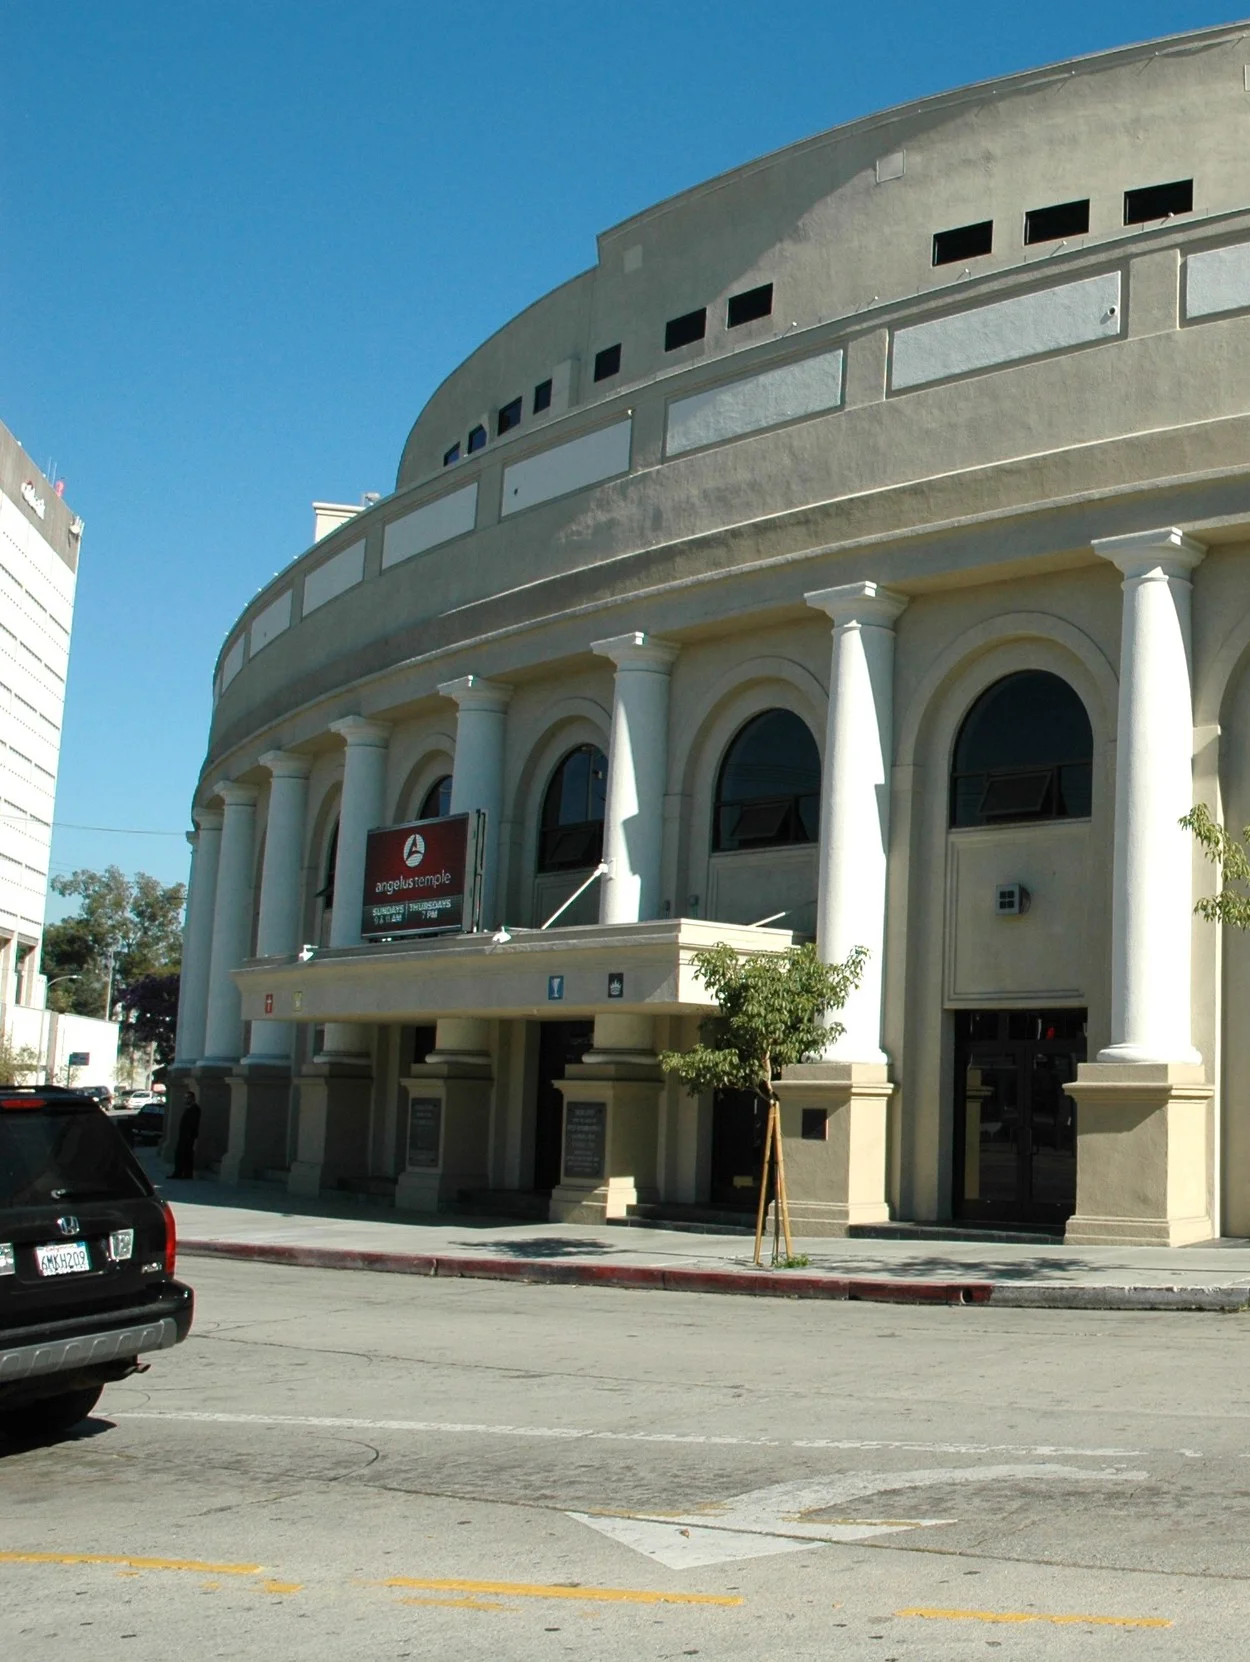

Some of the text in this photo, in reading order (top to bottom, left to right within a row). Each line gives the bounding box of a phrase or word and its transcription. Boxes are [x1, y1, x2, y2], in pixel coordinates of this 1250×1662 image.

[409, 899, 451, 911] THURSDAYS
[373, 905, 404, 916] SUNDAYS
[426, 910, 438, 919] PM
[391, 914, 402, 922] AM
